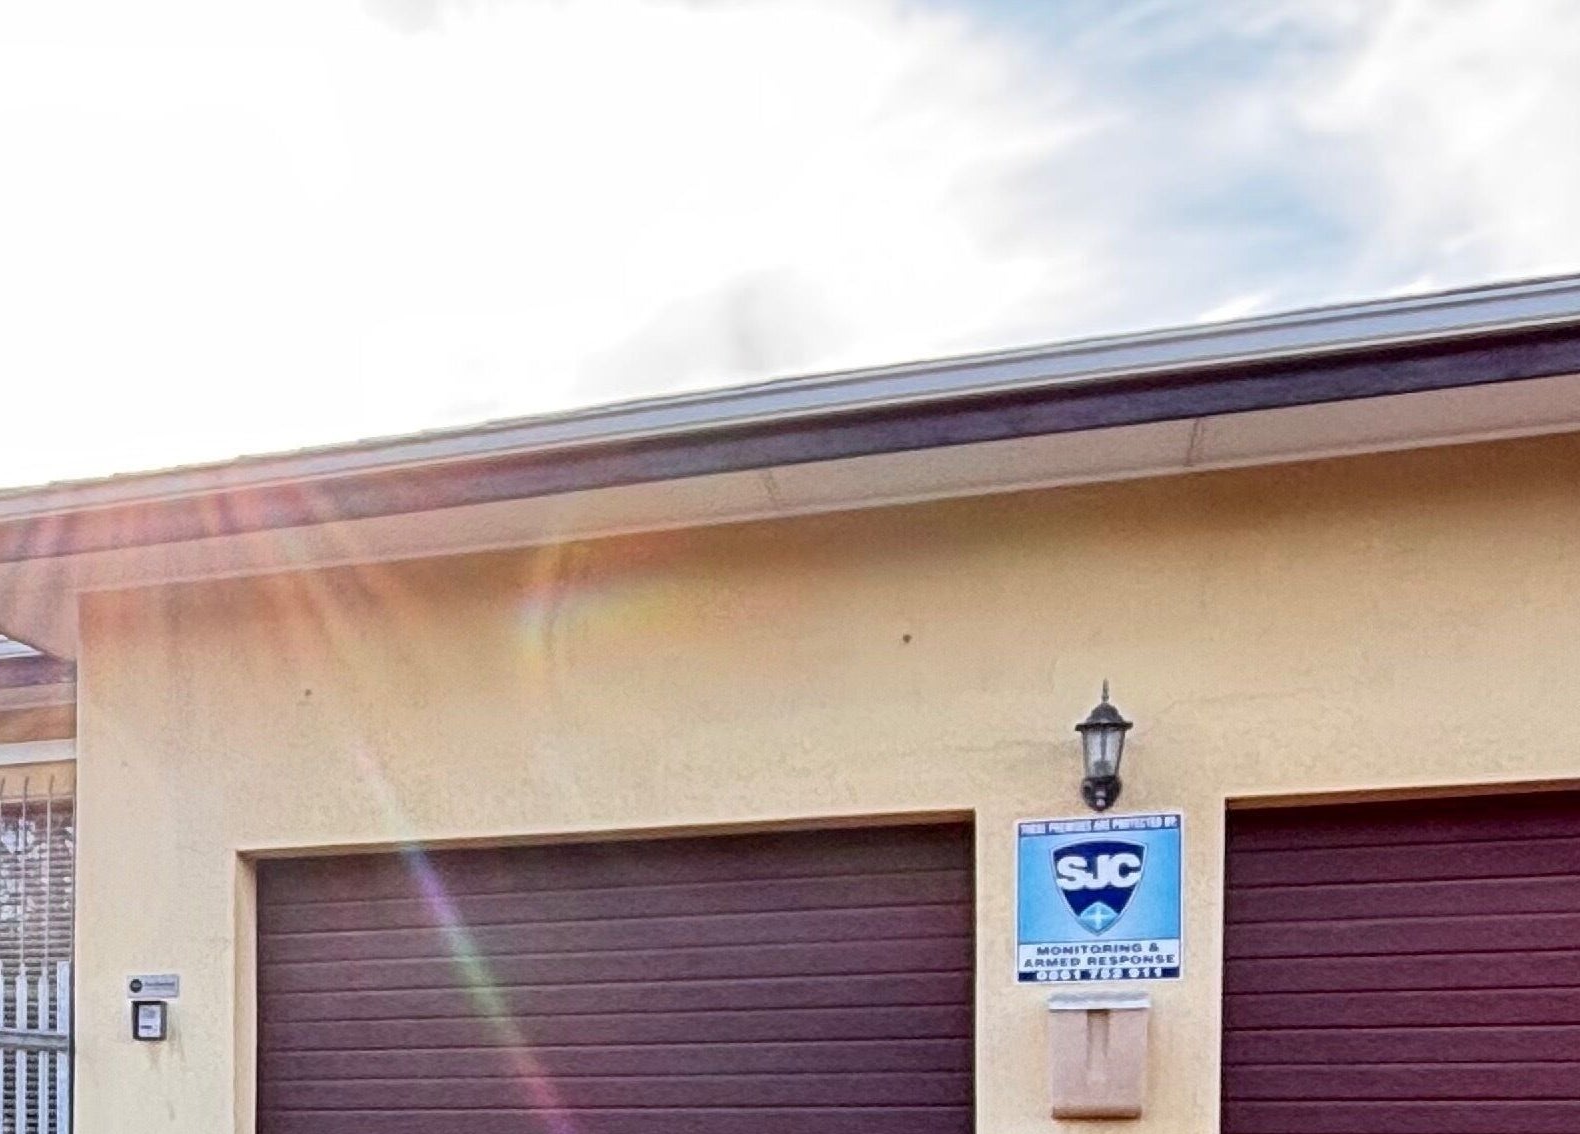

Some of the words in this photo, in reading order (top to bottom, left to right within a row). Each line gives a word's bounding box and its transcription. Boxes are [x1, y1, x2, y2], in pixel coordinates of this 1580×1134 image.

[1056, 852, 1142, 890] SJC
[1037, 943, 1142, 955] MONITORING
[1149, 942, 1159, 953] &
[1024, 957, 1080, 968] ARMED
[1087, 954, 1175, 966] RESPONSE
